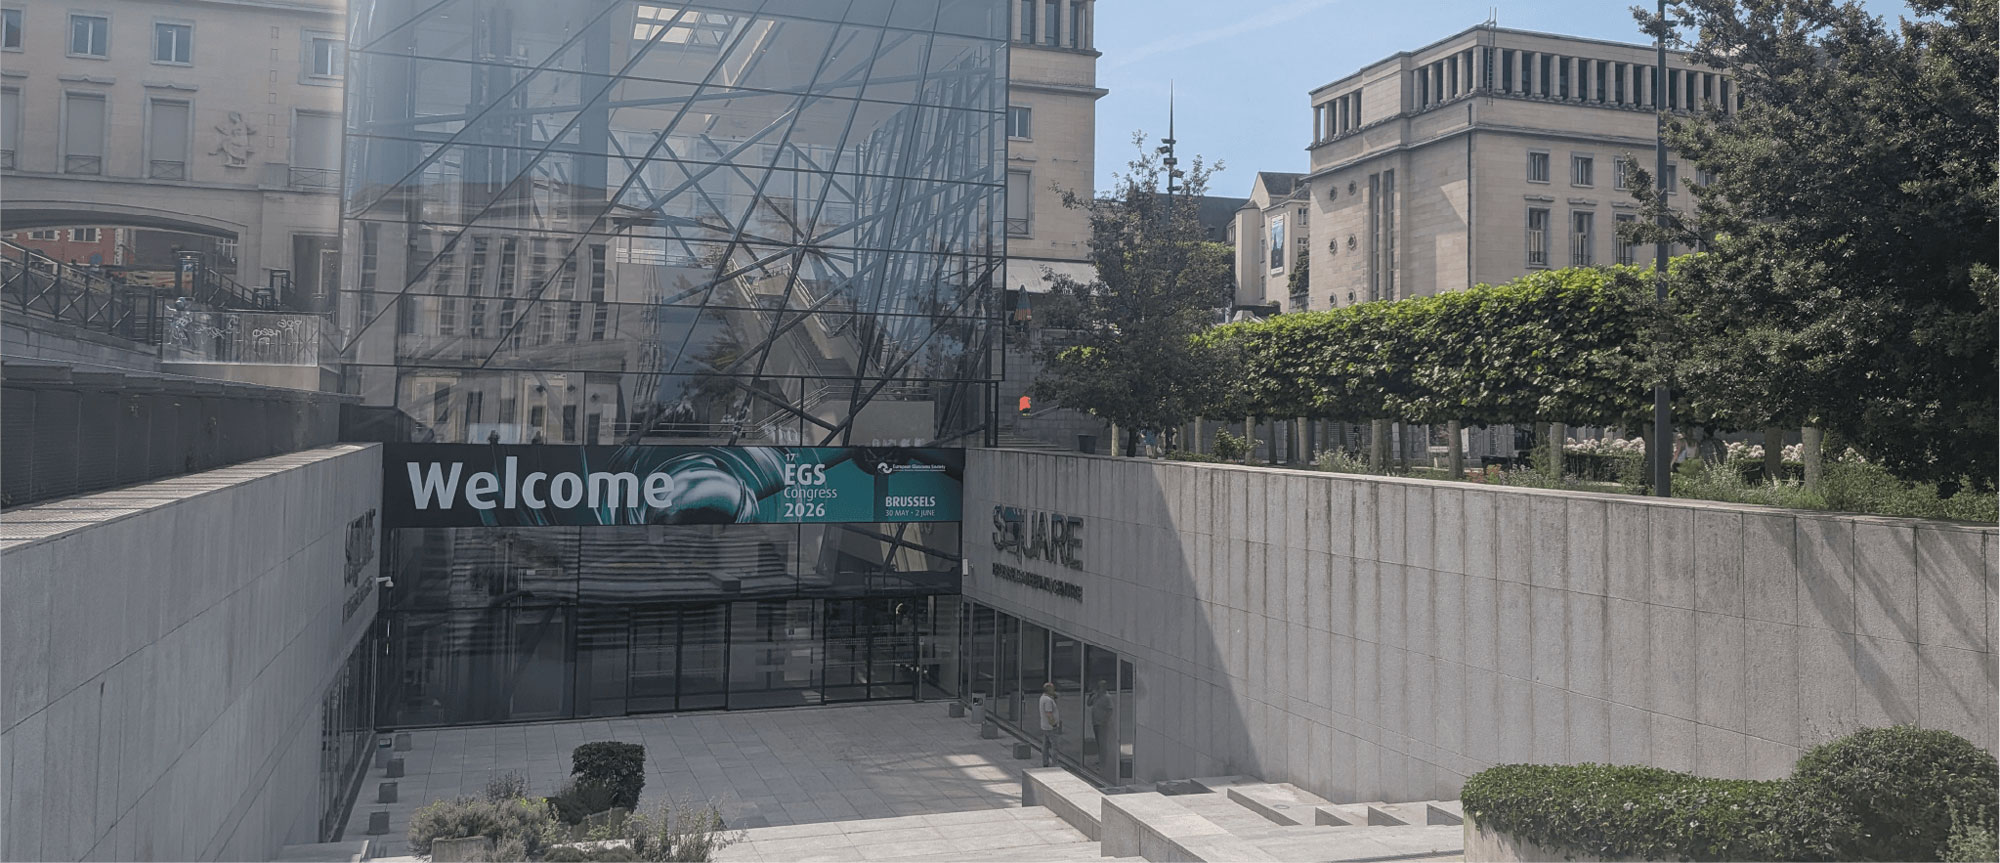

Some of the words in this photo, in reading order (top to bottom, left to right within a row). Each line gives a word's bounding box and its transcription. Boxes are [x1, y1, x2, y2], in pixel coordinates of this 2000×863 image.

[784, 463, 826, 486] EGS
[406, 456, 675, 510] Welcome
[784, 486, 838, 501] Congress
[885, 496, 936, 507] BRUSSELS
[784, 503, 826, 517] 2026
[885, 509, 894, 517] 30
[894, 509, 910, 517] MAY
[915, 509, 920, 517] 2
[920, 509, 935, 517] JUNE
[992, 504, 1084, 571] SQUARE
